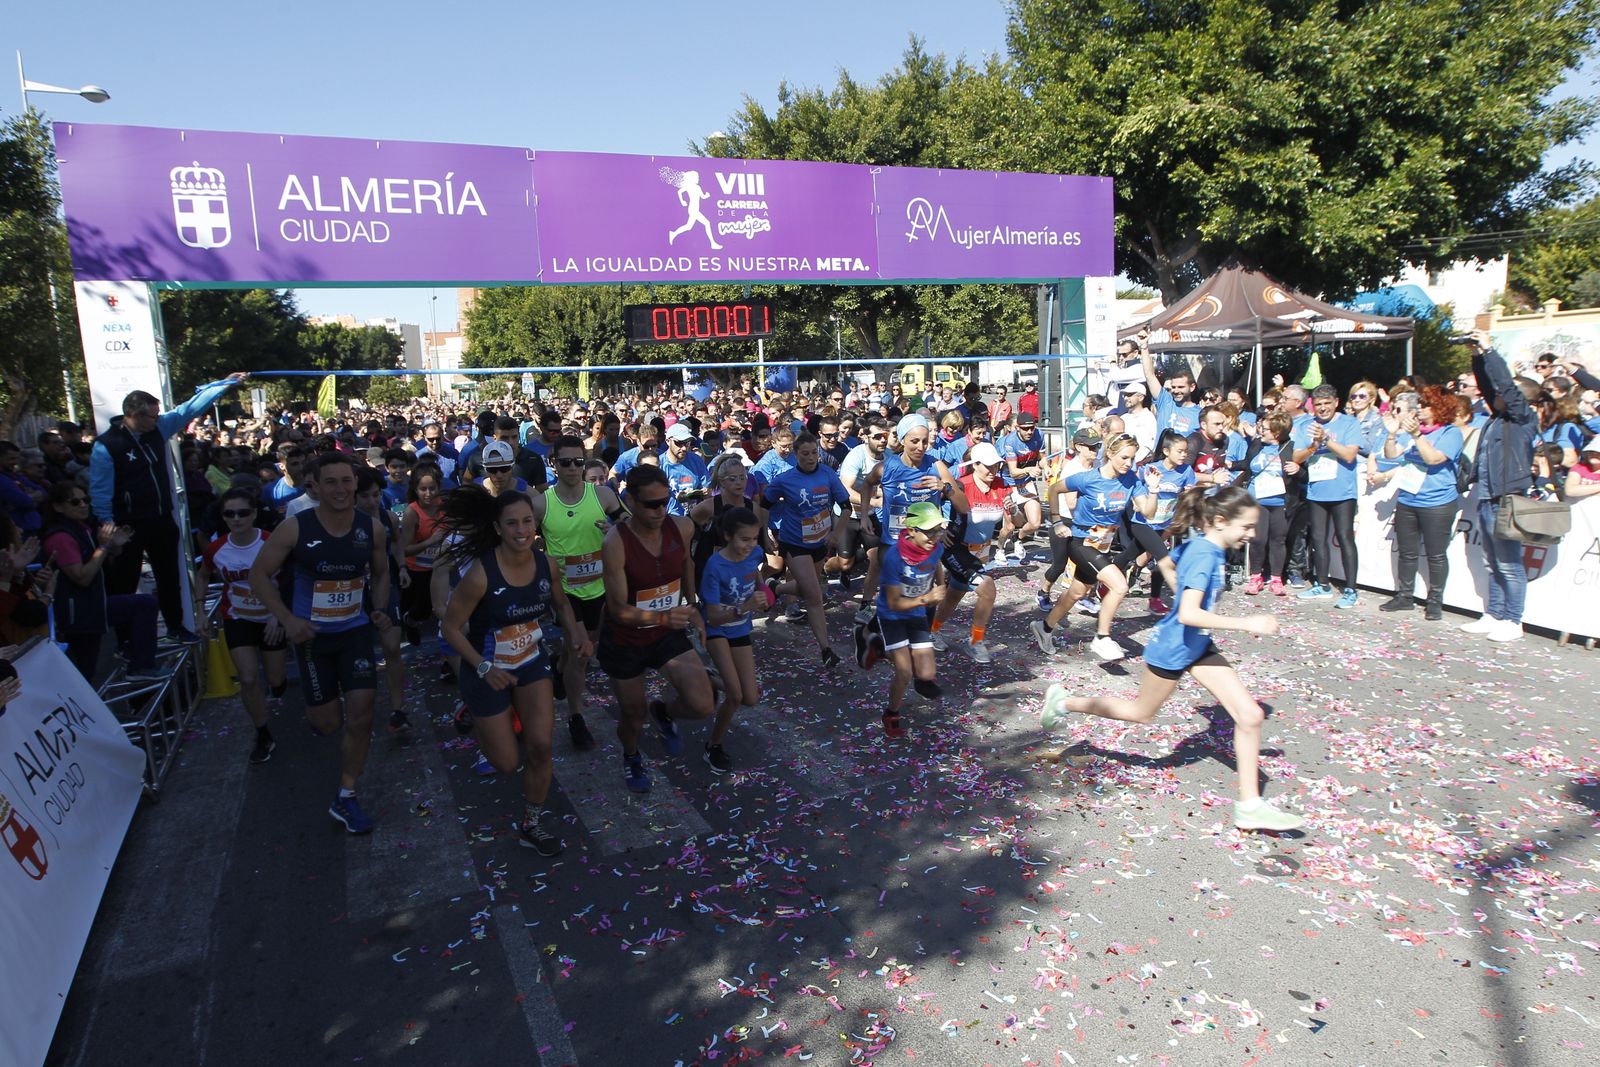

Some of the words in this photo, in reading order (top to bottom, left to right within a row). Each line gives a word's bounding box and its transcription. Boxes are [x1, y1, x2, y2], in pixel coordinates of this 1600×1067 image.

[714, 172, 765, 195] VIII
[278, 172, 488, 216] ALMERÍA
[717, 200, 768, 209] CARRERA
[280, 218, 390, 243] CIUDAD
[553, 257, 579, 272] LA
[586, 257, 692, 272] IGUALDAD
[699, 257, 721, 271] ES
[727, 257, 811, 271] NUESTRA
[816, 257, 870, 271] META.
[105, 340, 131, 351] CDX
[577, 562, 597, 574] 317
[327, 593, 352, 604] 381
[649, 595, 673, 609] 419
[511, 634, 533, 651] 382
[44, 762, 85, 826] CIUDAD
